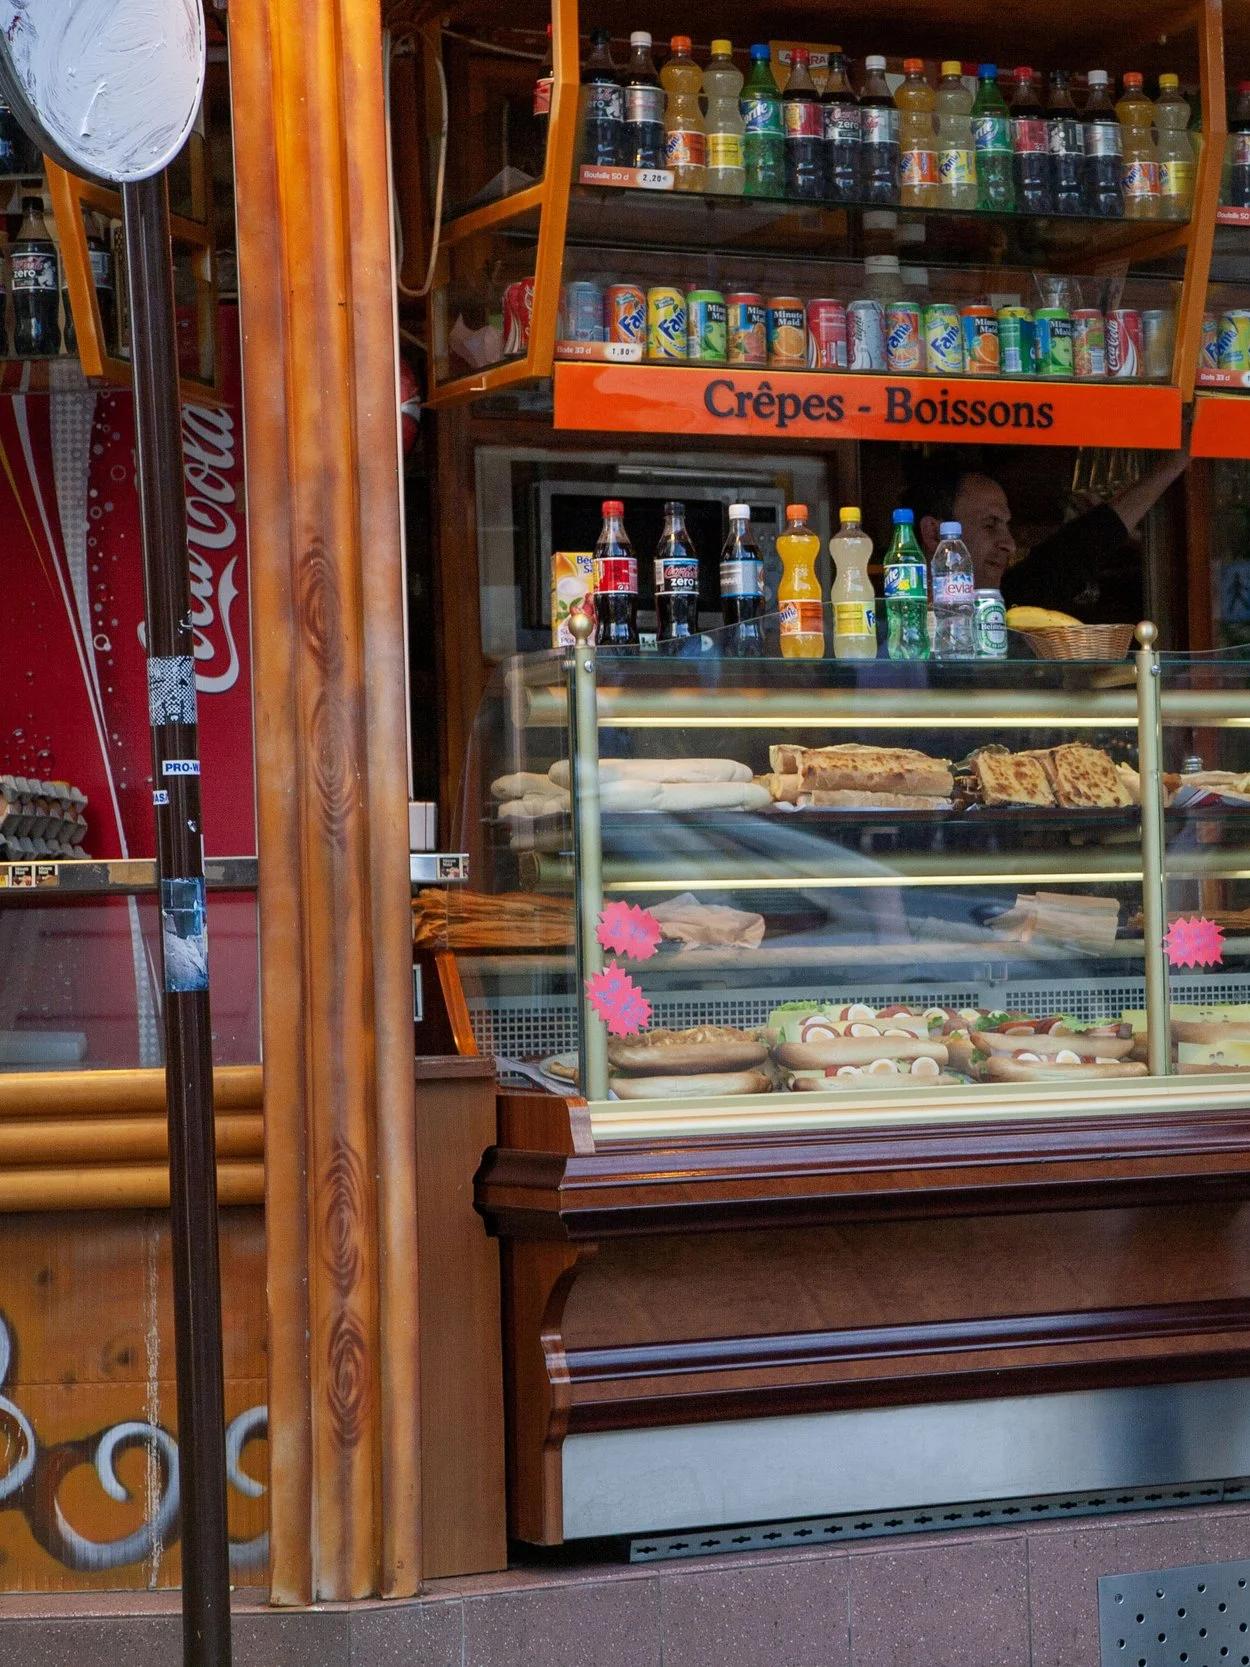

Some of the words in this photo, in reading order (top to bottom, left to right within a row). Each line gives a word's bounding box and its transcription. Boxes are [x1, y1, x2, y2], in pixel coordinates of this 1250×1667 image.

[838, 120, 860, 129] zero
[14, 269, 36, 278] zero
[774, 311, 802, 319] Minute
[703, 379, 845, 428] Crêpes
[884, 387, 1054, 429] Boissons
[670, 577, 694, 586] zero
